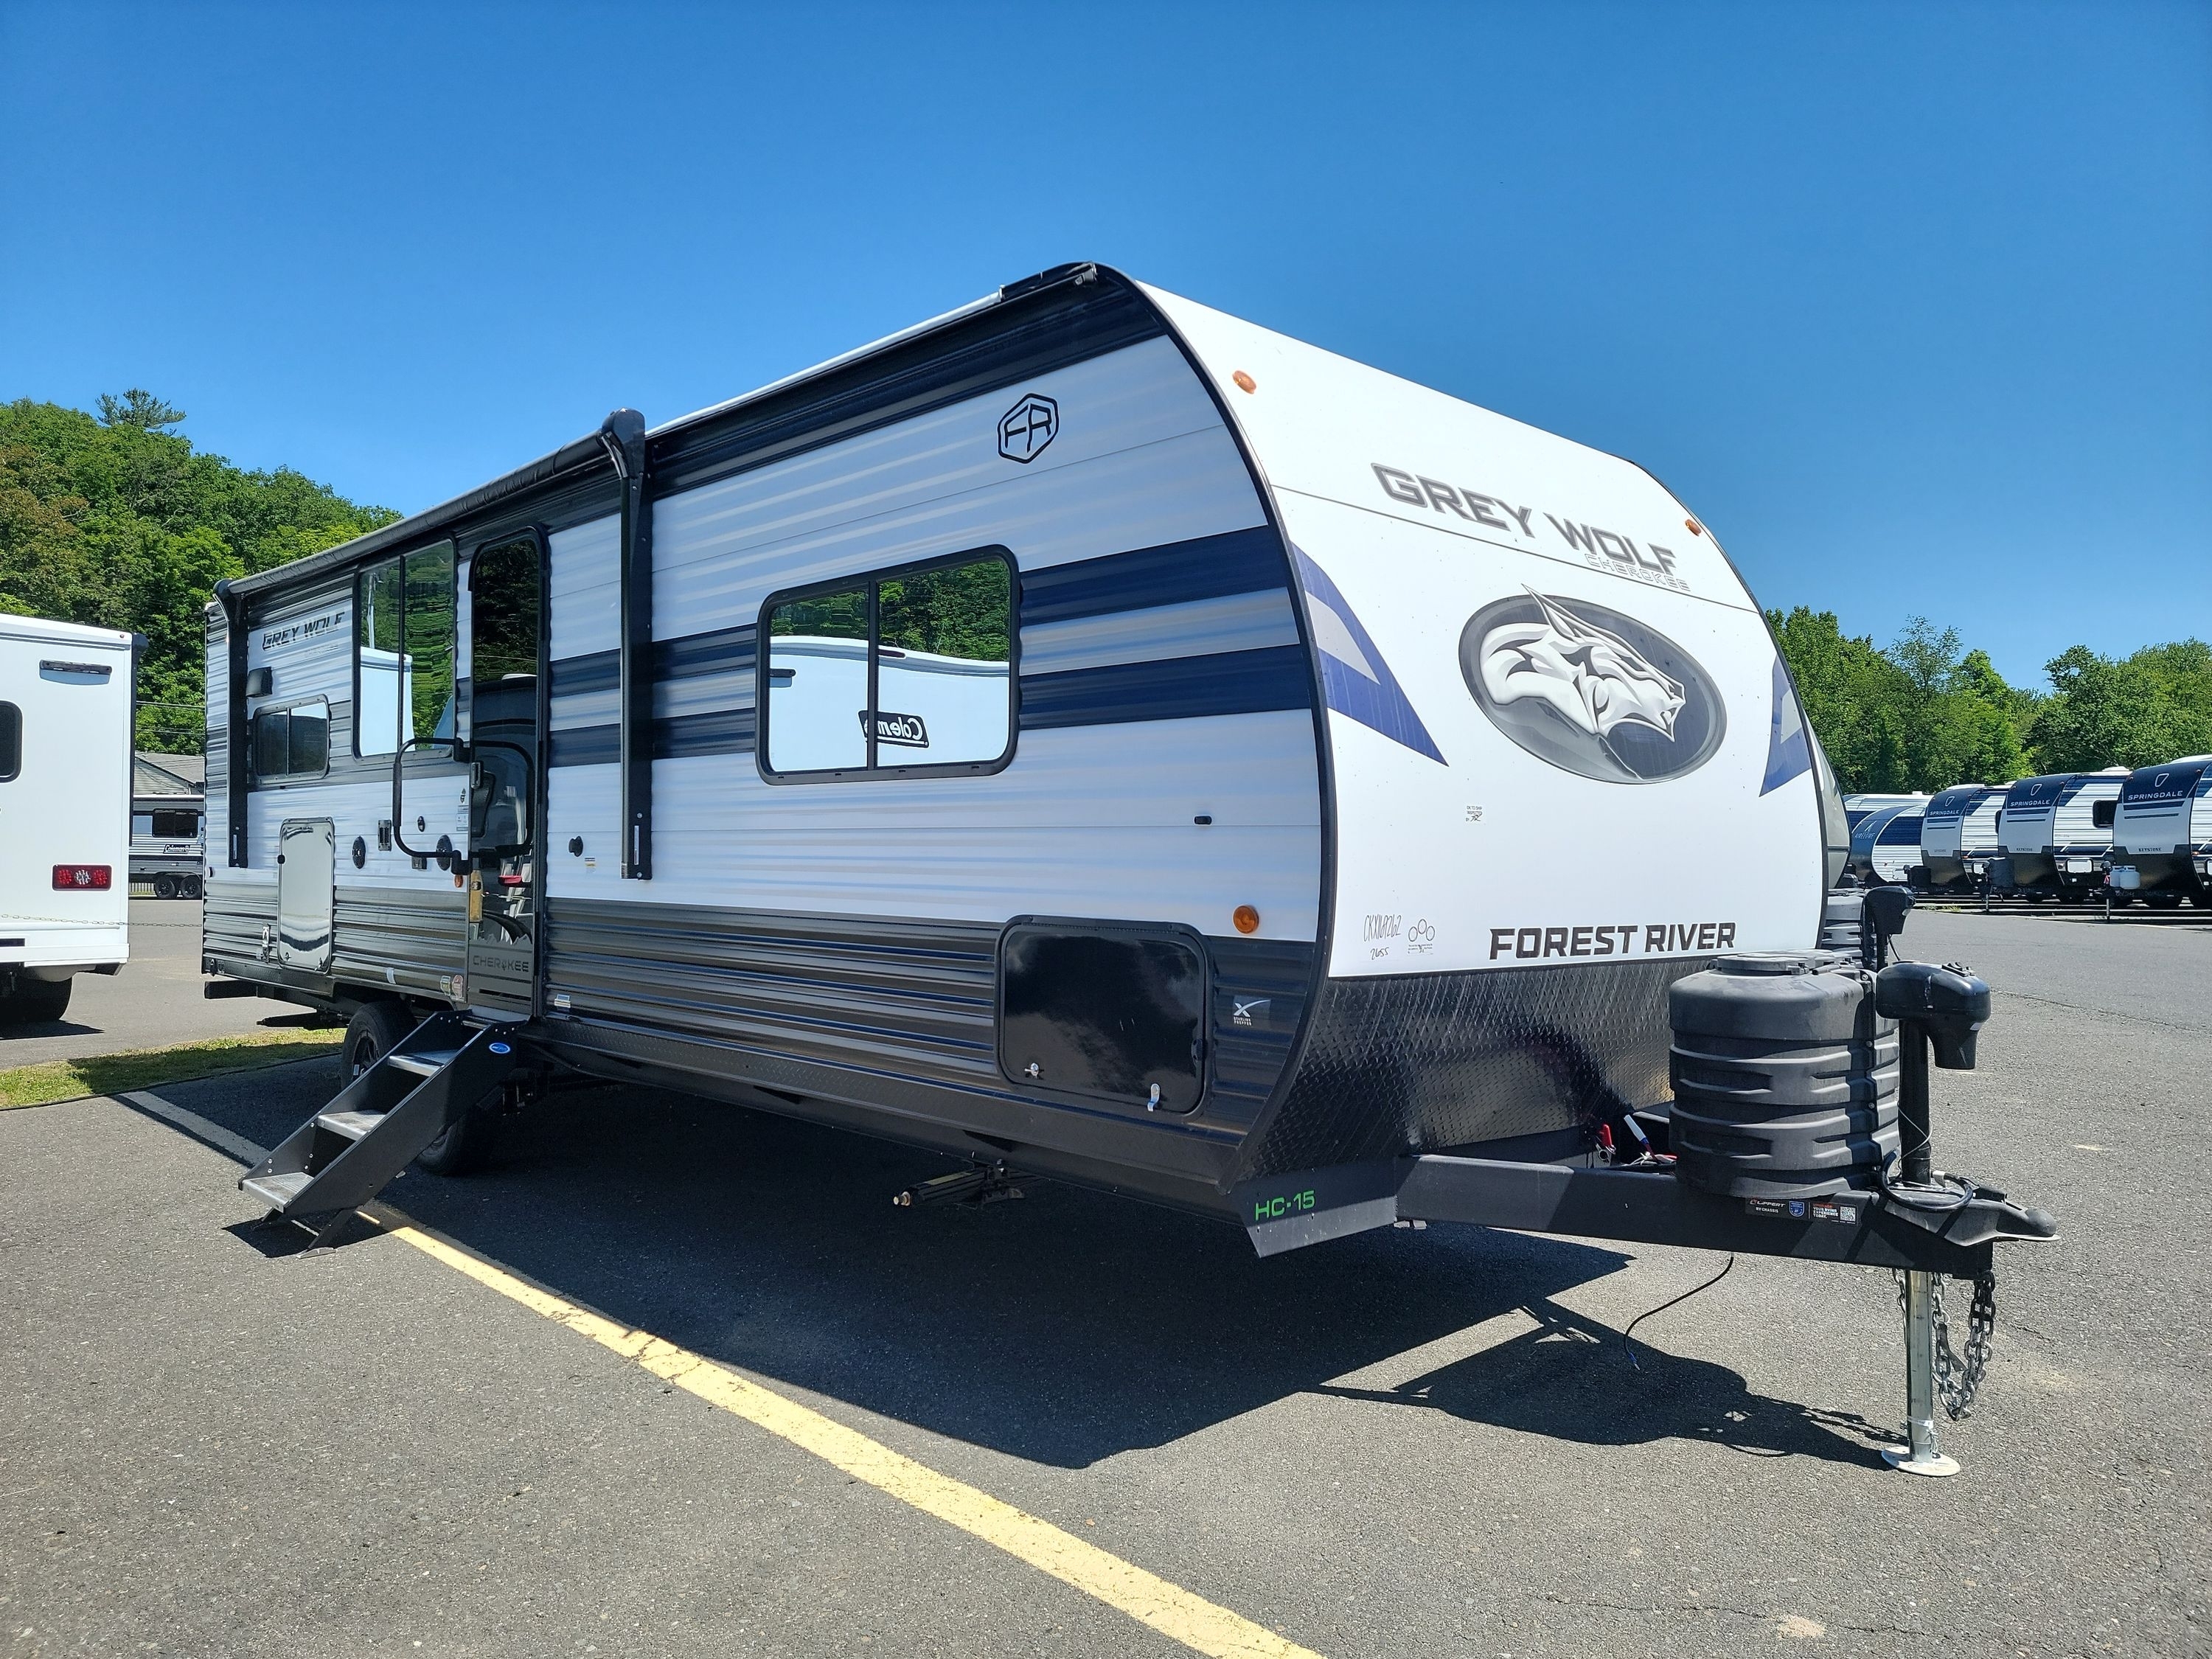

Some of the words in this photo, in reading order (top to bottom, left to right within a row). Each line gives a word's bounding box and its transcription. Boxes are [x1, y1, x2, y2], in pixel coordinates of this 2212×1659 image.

[1371, 462, 1535, 538] GREY
[1543, 512, 1677, 577] WOLF
[1585, 553, 1691, 592] CHEROKEE
[262, 626, 299, 650] GREY
[303, 611, 345, 639] WOLF
[2126, 790, 2183, 801] SPRINGDALE
[1489, 925, 1638, 960] FOREST
[1645, 922, 1736, 953] RIVER
[1255, 1189, 1315, 1222] HC-15
